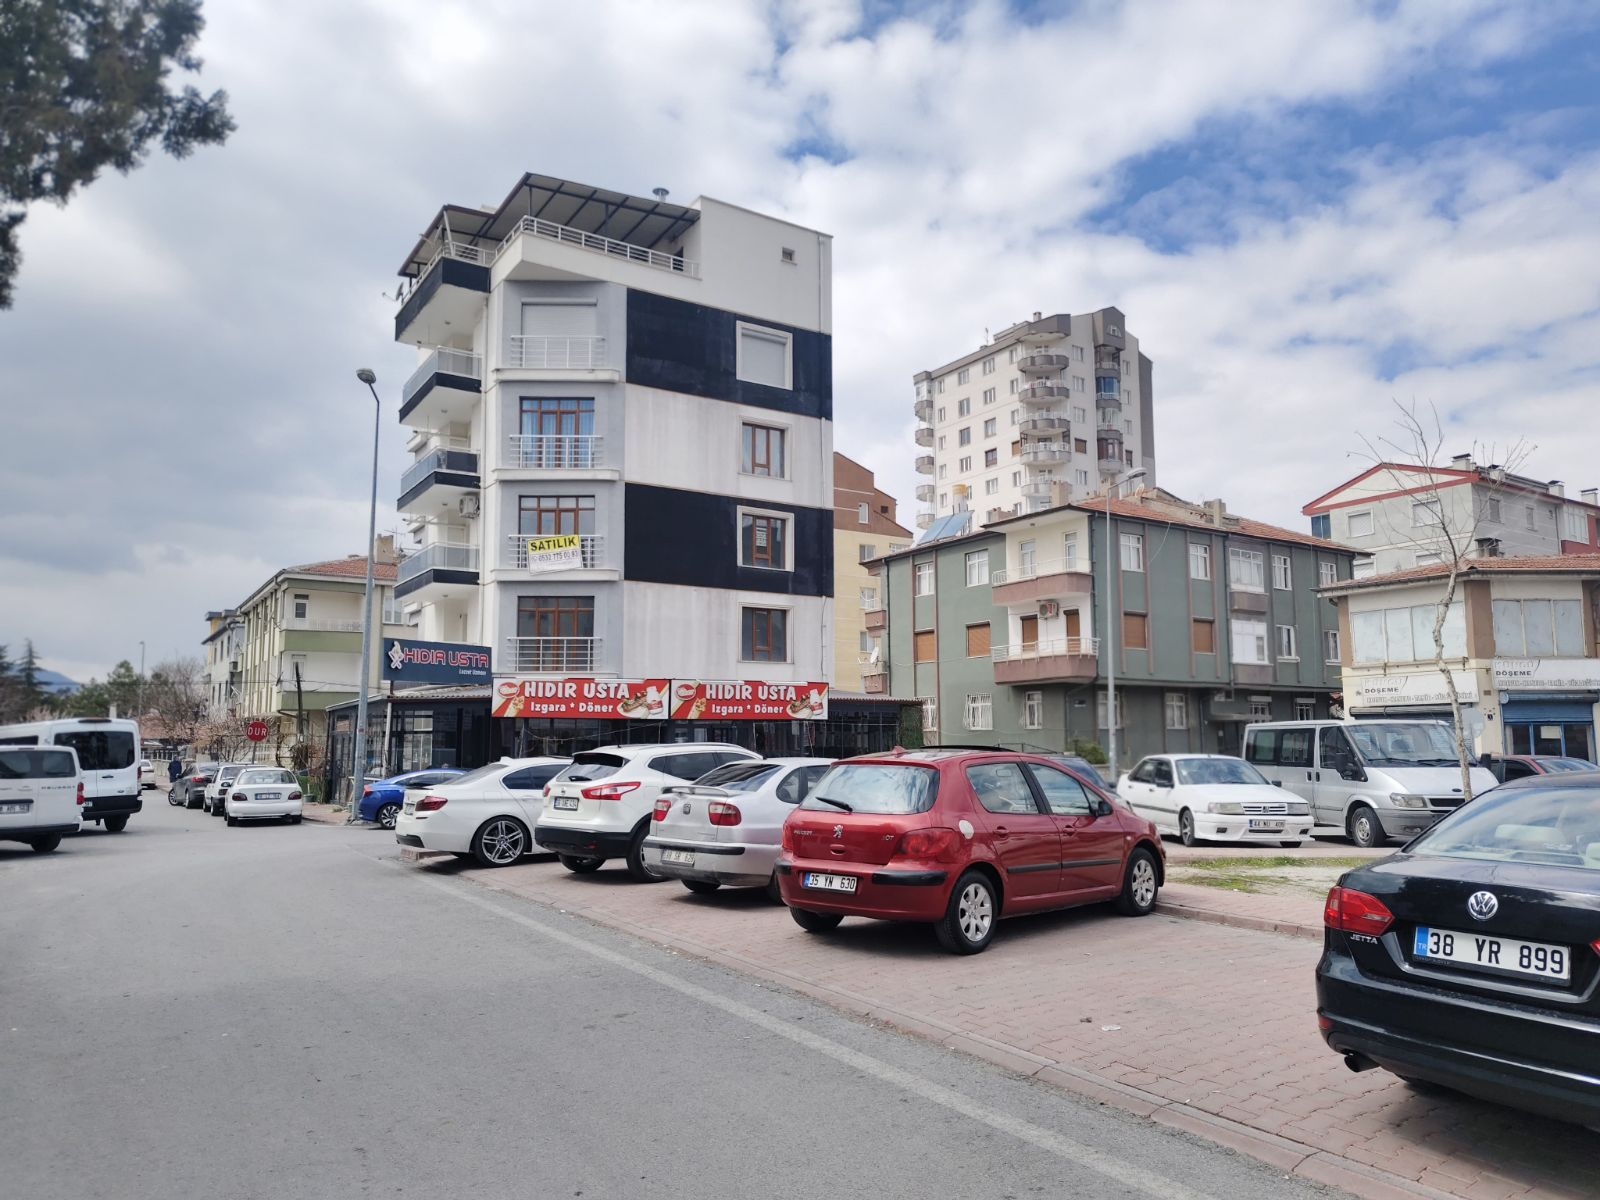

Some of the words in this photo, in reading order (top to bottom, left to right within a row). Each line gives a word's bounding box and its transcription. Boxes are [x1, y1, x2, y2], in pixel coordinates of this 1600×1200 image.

[530, 536, 576, 551] SATILIK
[448, 651, 489, 668] USTA
[524, 681, 577, 698] HIDIR
[583, 682, 630, 699] USTA
[705, 684, 753, 701] HIDIR
[757, 685, 797, 702] USTA
[530, 702, 567, 714] Izgara
[578, 702, 614, 713] Döner
[711, 704, 744, 716] Izgara
[754, 703, 784, 714] Döner
[247, 726, 267, 737] DUR
[809, 873, 819, 886] 35
[824, 876, 834, 888] YN
[840, 877, 856, 890] 630
[1350, 933, 1378, 945] JETTA
[1417, 942, 1428, 950] TR
[1429, 932, 1455, 957] 38
[1475, 938, 1501, 964] YR
[1519, 945, 1564, 974] 899
